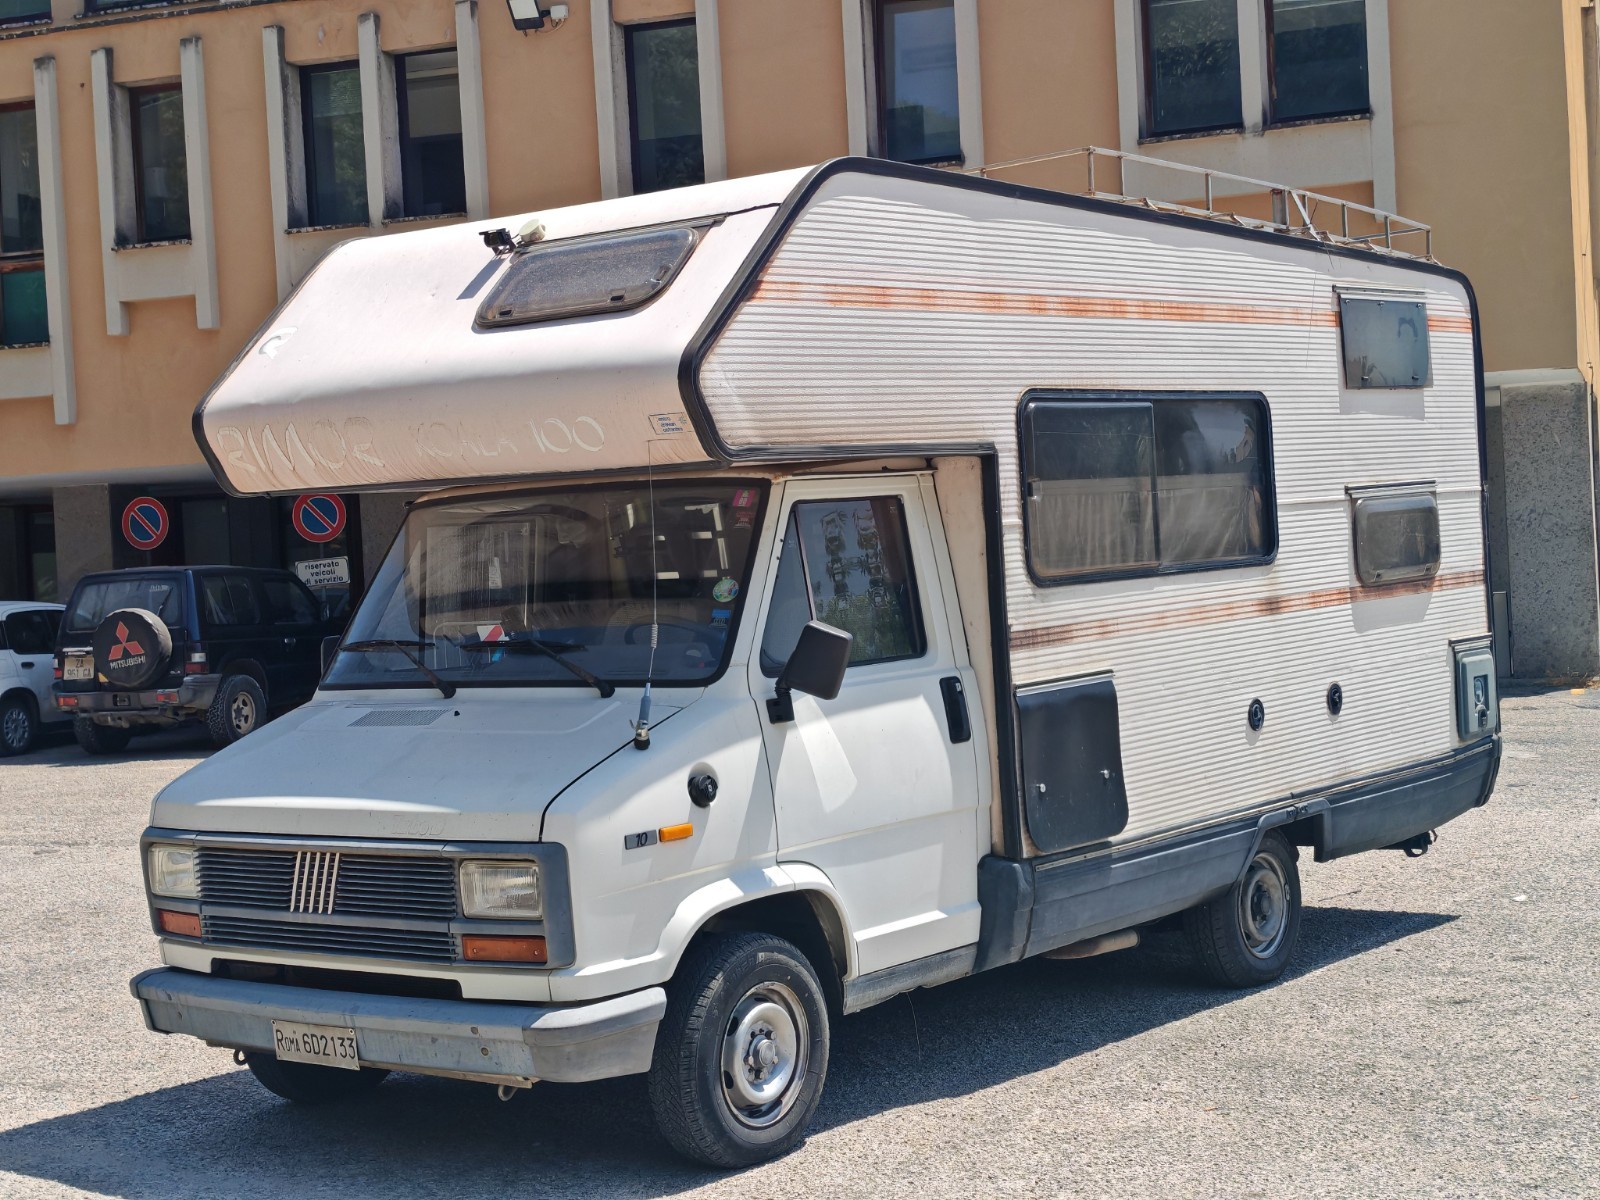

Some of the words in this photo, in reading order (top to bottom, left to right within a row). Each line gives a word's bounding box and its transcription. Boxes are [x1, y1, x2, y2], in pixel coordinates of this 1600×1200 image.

[217, 416, 386, 473] RIMOR
[529, 416, 605, 453] 100
[304, 561, 339, 570] riservato
[310, 569, 335, 577] veicoli
[314, 576, 343, 584] servizio
[110, 656, 146, 669] MITSUBISHI
[635, 832, 648, 847] 10
[302, 1033, 356, 1060] 6D2133
